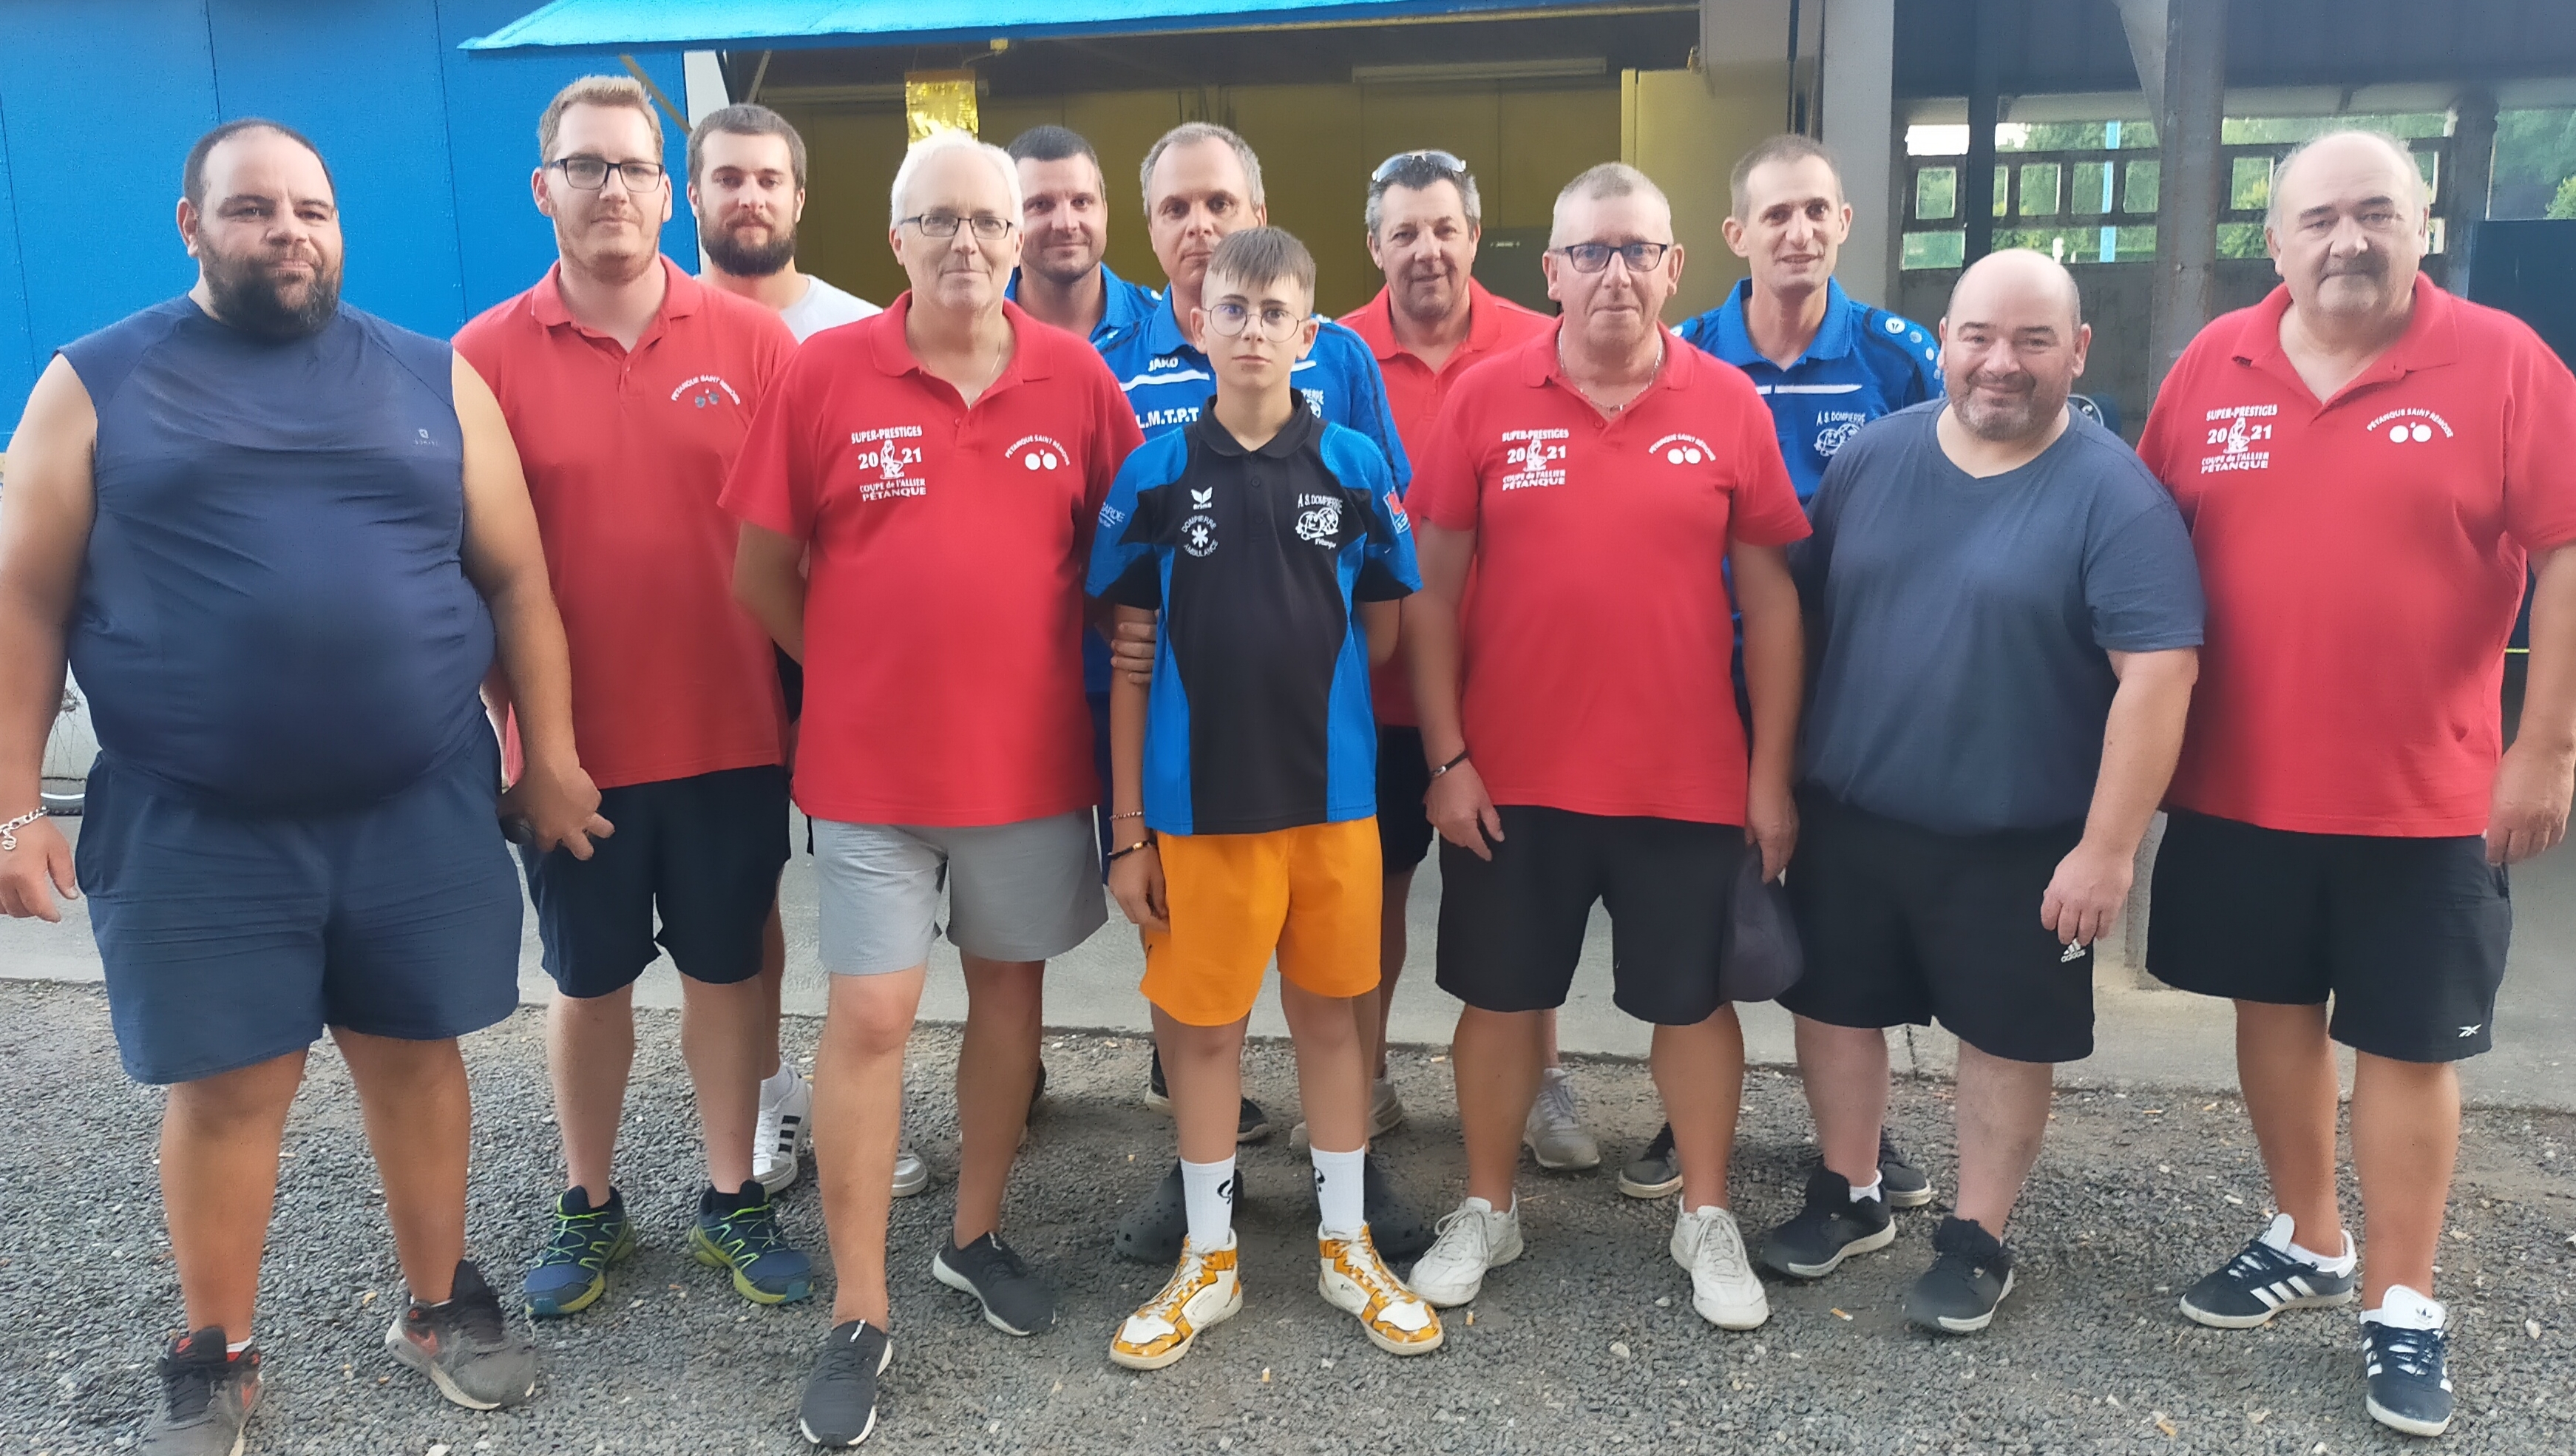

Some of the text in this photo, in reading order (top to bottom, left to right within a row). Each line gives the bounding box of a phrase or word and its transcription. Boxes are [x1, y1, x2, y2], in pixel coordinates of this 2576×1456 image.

[1148, 356, 1179, 372] JAKO
[2407, 407, 2430, 418] SAINT
[1034, 433, 1052, 444] SAINT
[2207, 424, 2272, 444] 20 21
[858, 447, 922, 470] 20 21
[1507, 445, 1566, 464] 20 21
[2201, 455, 2225, 466] COUPE
[859, 482, 884, 493] COUPE
[887, 481, 895, 489] de
[1181, 515, 1217, 533] DOMPIERRE
[1183, 538, 1218, 558] AMBULANCE
